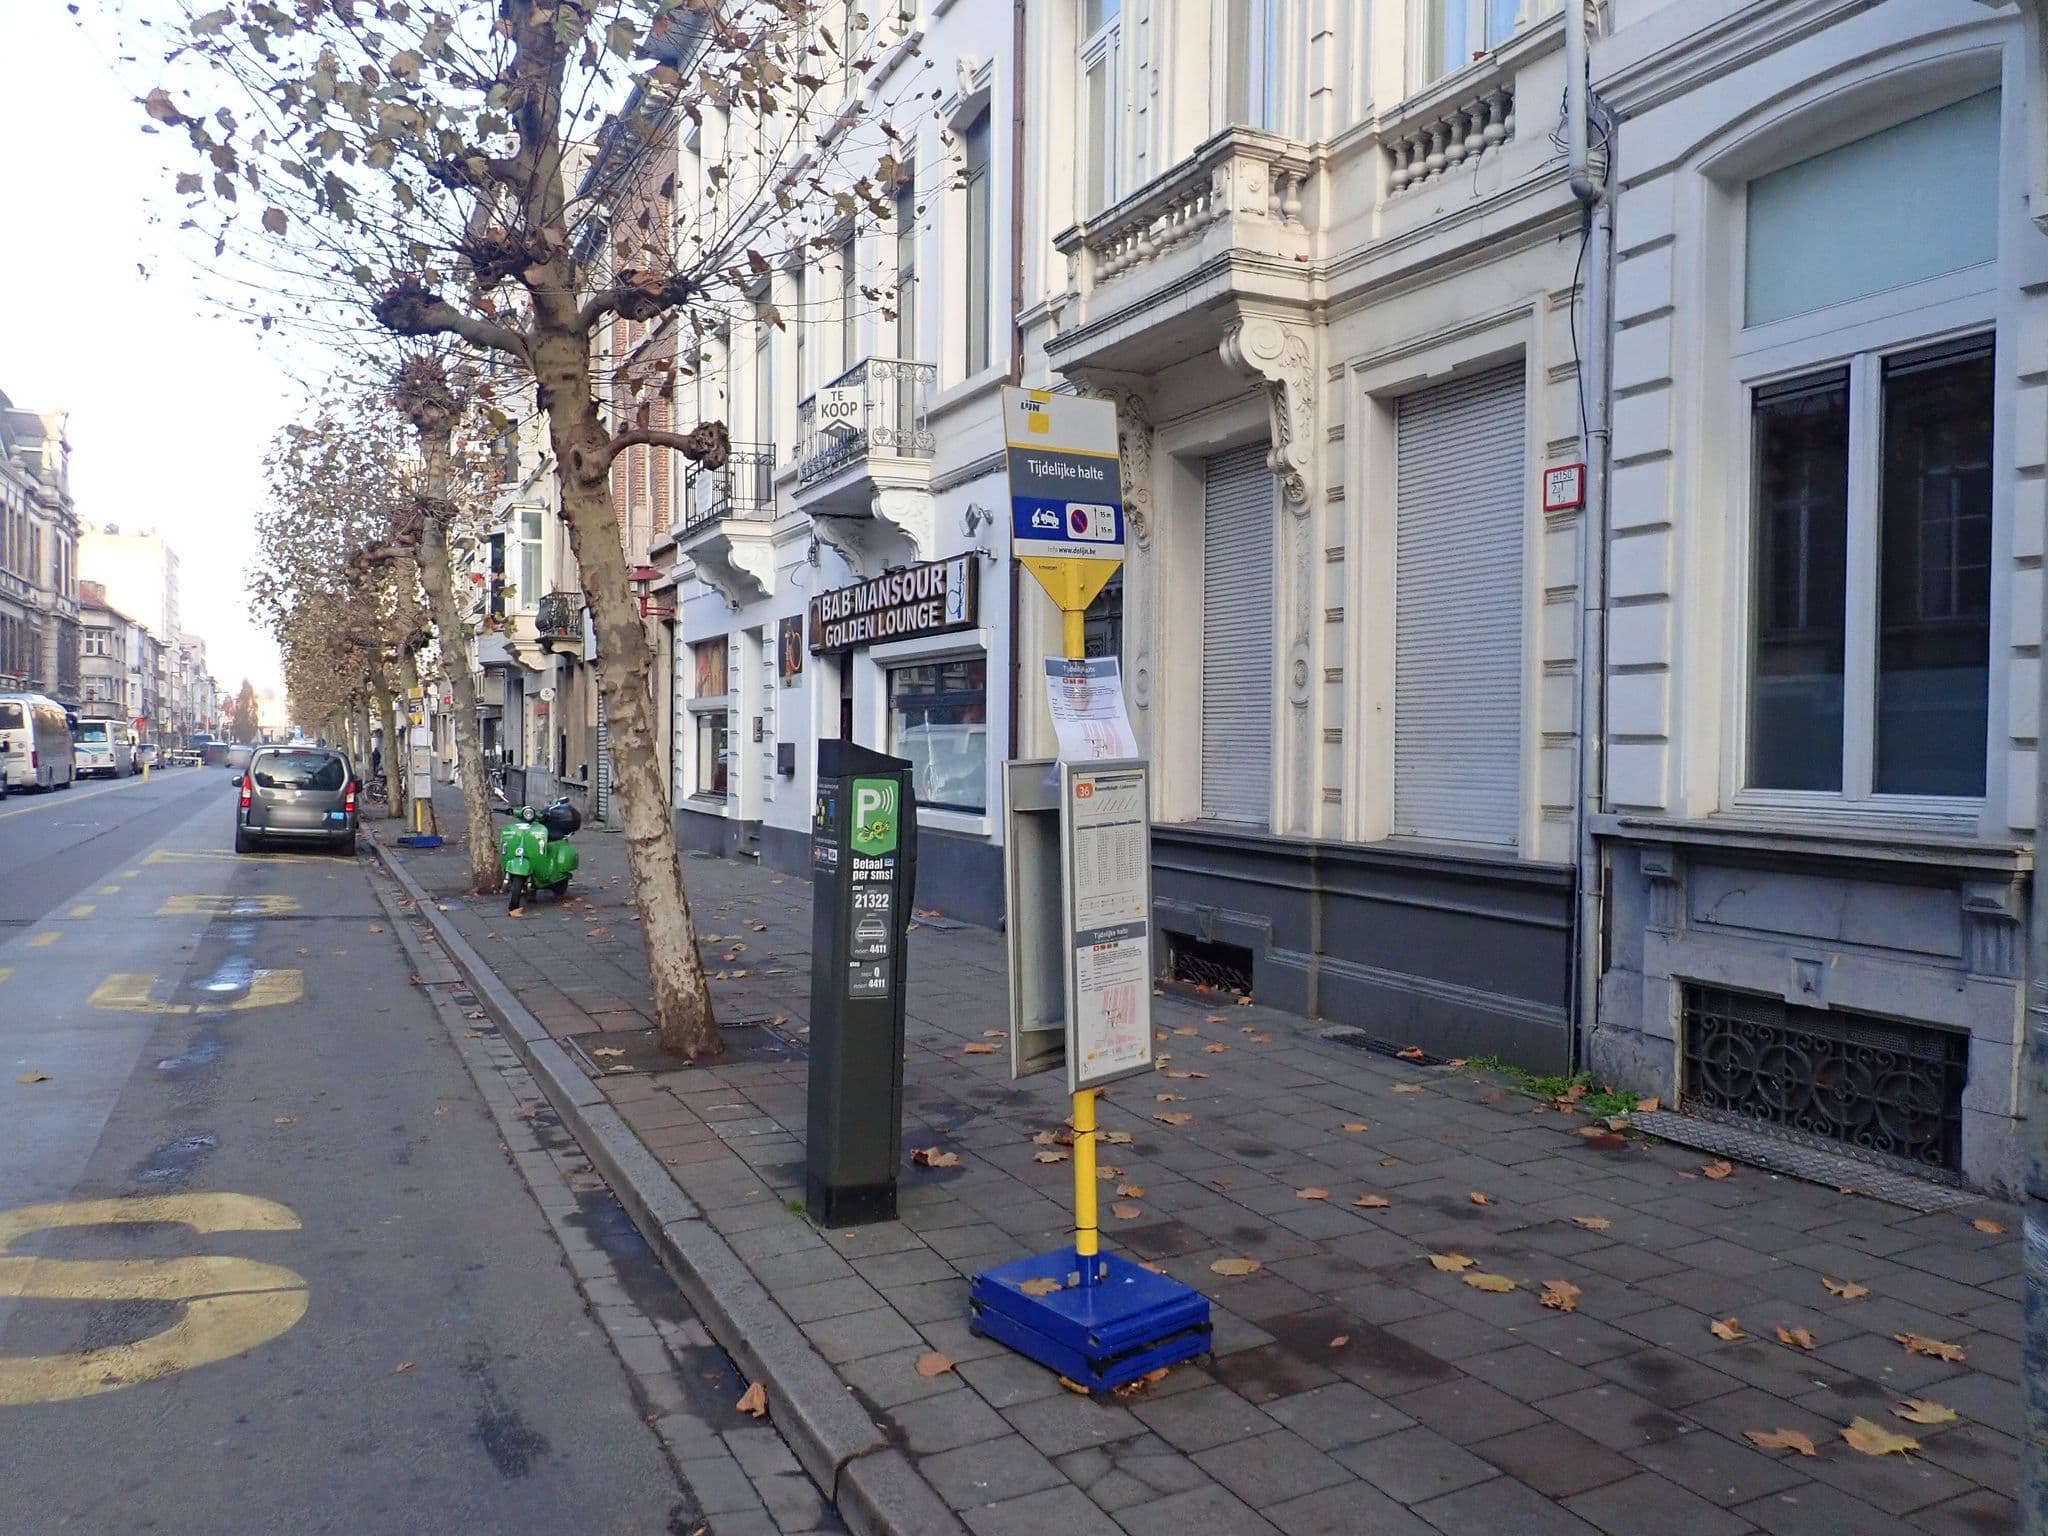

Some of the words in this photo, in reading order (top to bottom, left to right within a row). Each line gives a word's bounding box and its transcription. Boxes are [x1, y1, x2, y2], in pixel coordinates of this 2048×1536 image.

[830, 390, 844, 401] TE
[821, 402, 858, 418] KOOP
[1027, 459, 1077, 480] Tijdelijke
[1078, 464, 1104, 480] halte
[821, 591, 852, 622] BAB
[854, 564, 946, 614] MANSOUR
[825, 614, 874, 648] GOLDEN
[877, 601, 939, 636] LOUNGE
[1079, 786, 1090, 798] 36
[857, 788, 881, 829] P
[853, 858, 883, 870] Betaal
[852, 870, 869, 881] per
[870, 868, 894, 880] sms!
[855, 893, 889, 909] 21322
[869, 944, 887, 954] 4411
[868, 978, 885, 988] 4411
